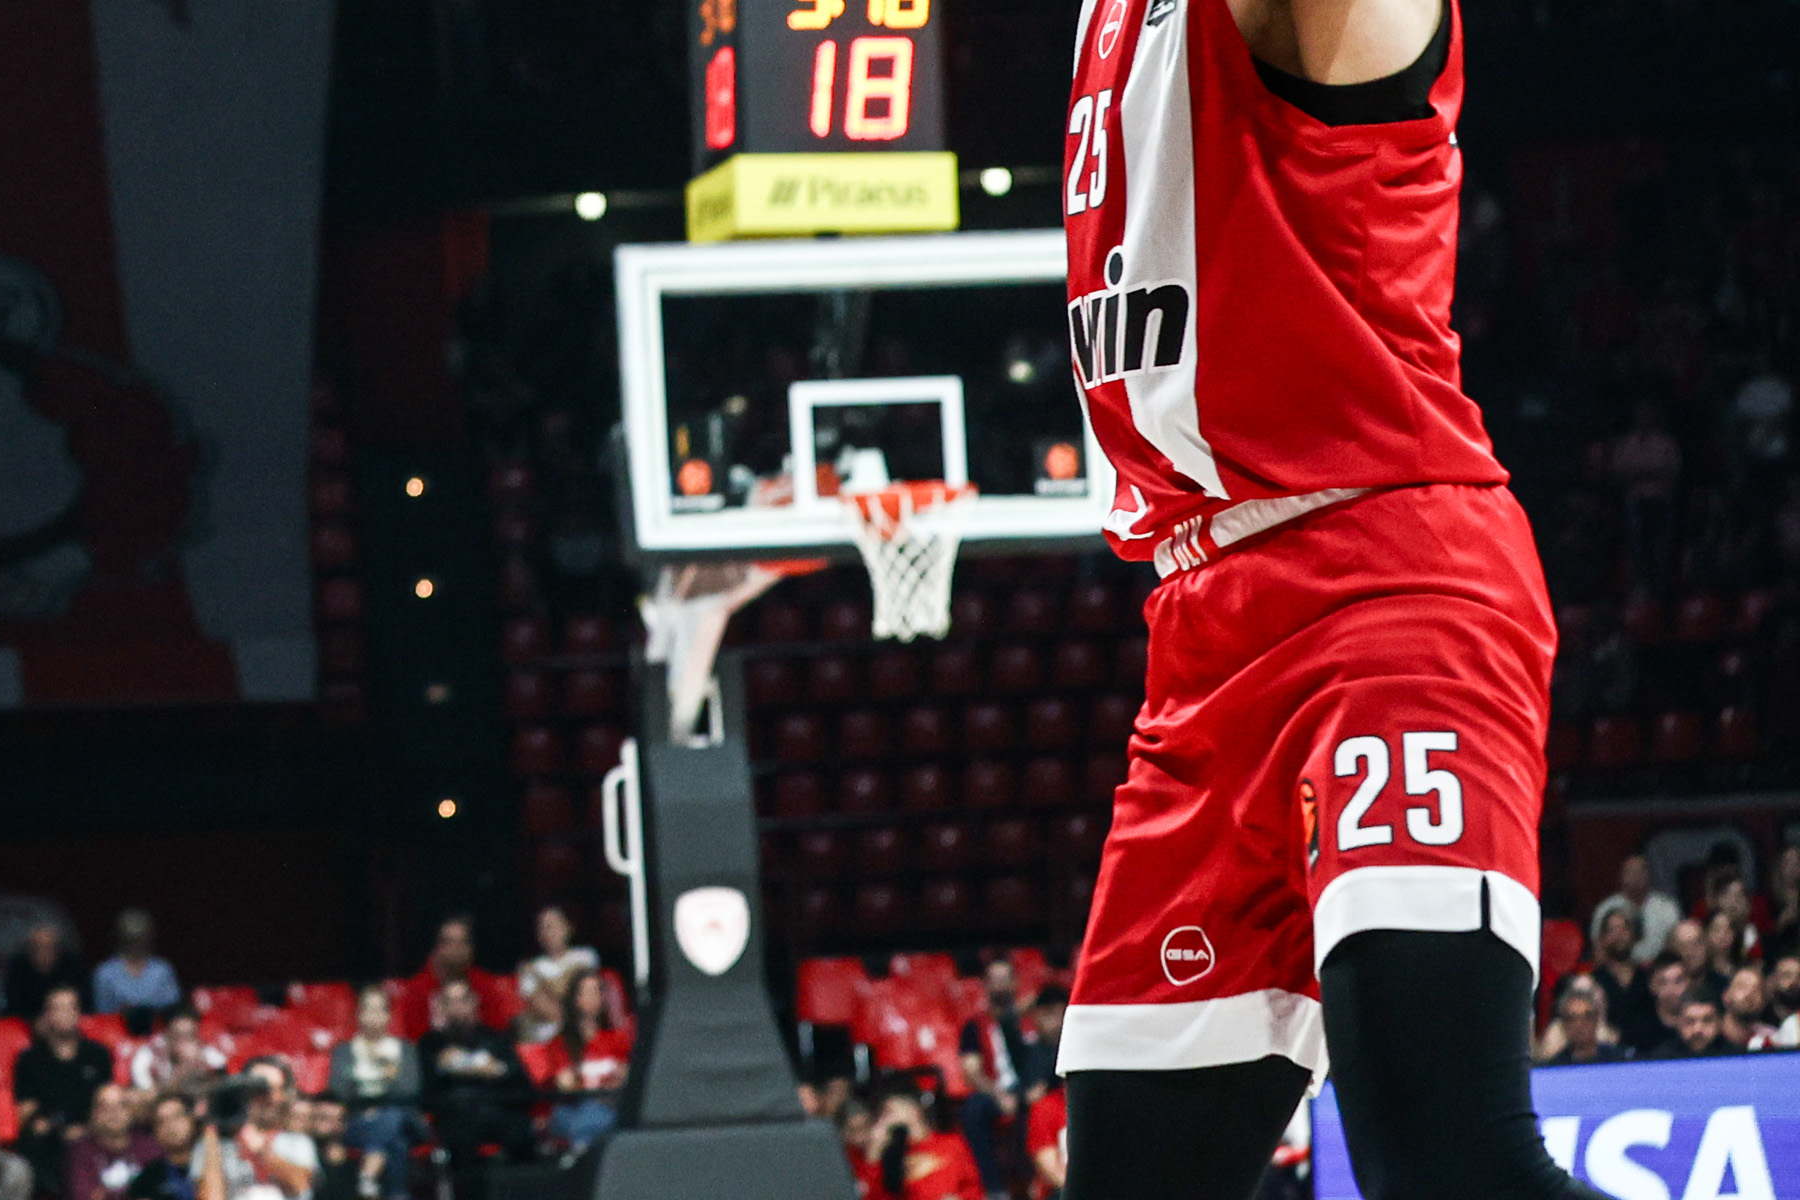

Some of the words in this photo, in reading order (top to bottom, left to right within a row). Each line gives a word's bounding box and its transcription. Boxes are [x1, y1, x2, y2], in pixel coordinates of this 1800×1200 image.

[810, 36, 915, 141] 18
[1066, 88, 1113, 216] 25
[1333, 731, 1464, 852] 25
